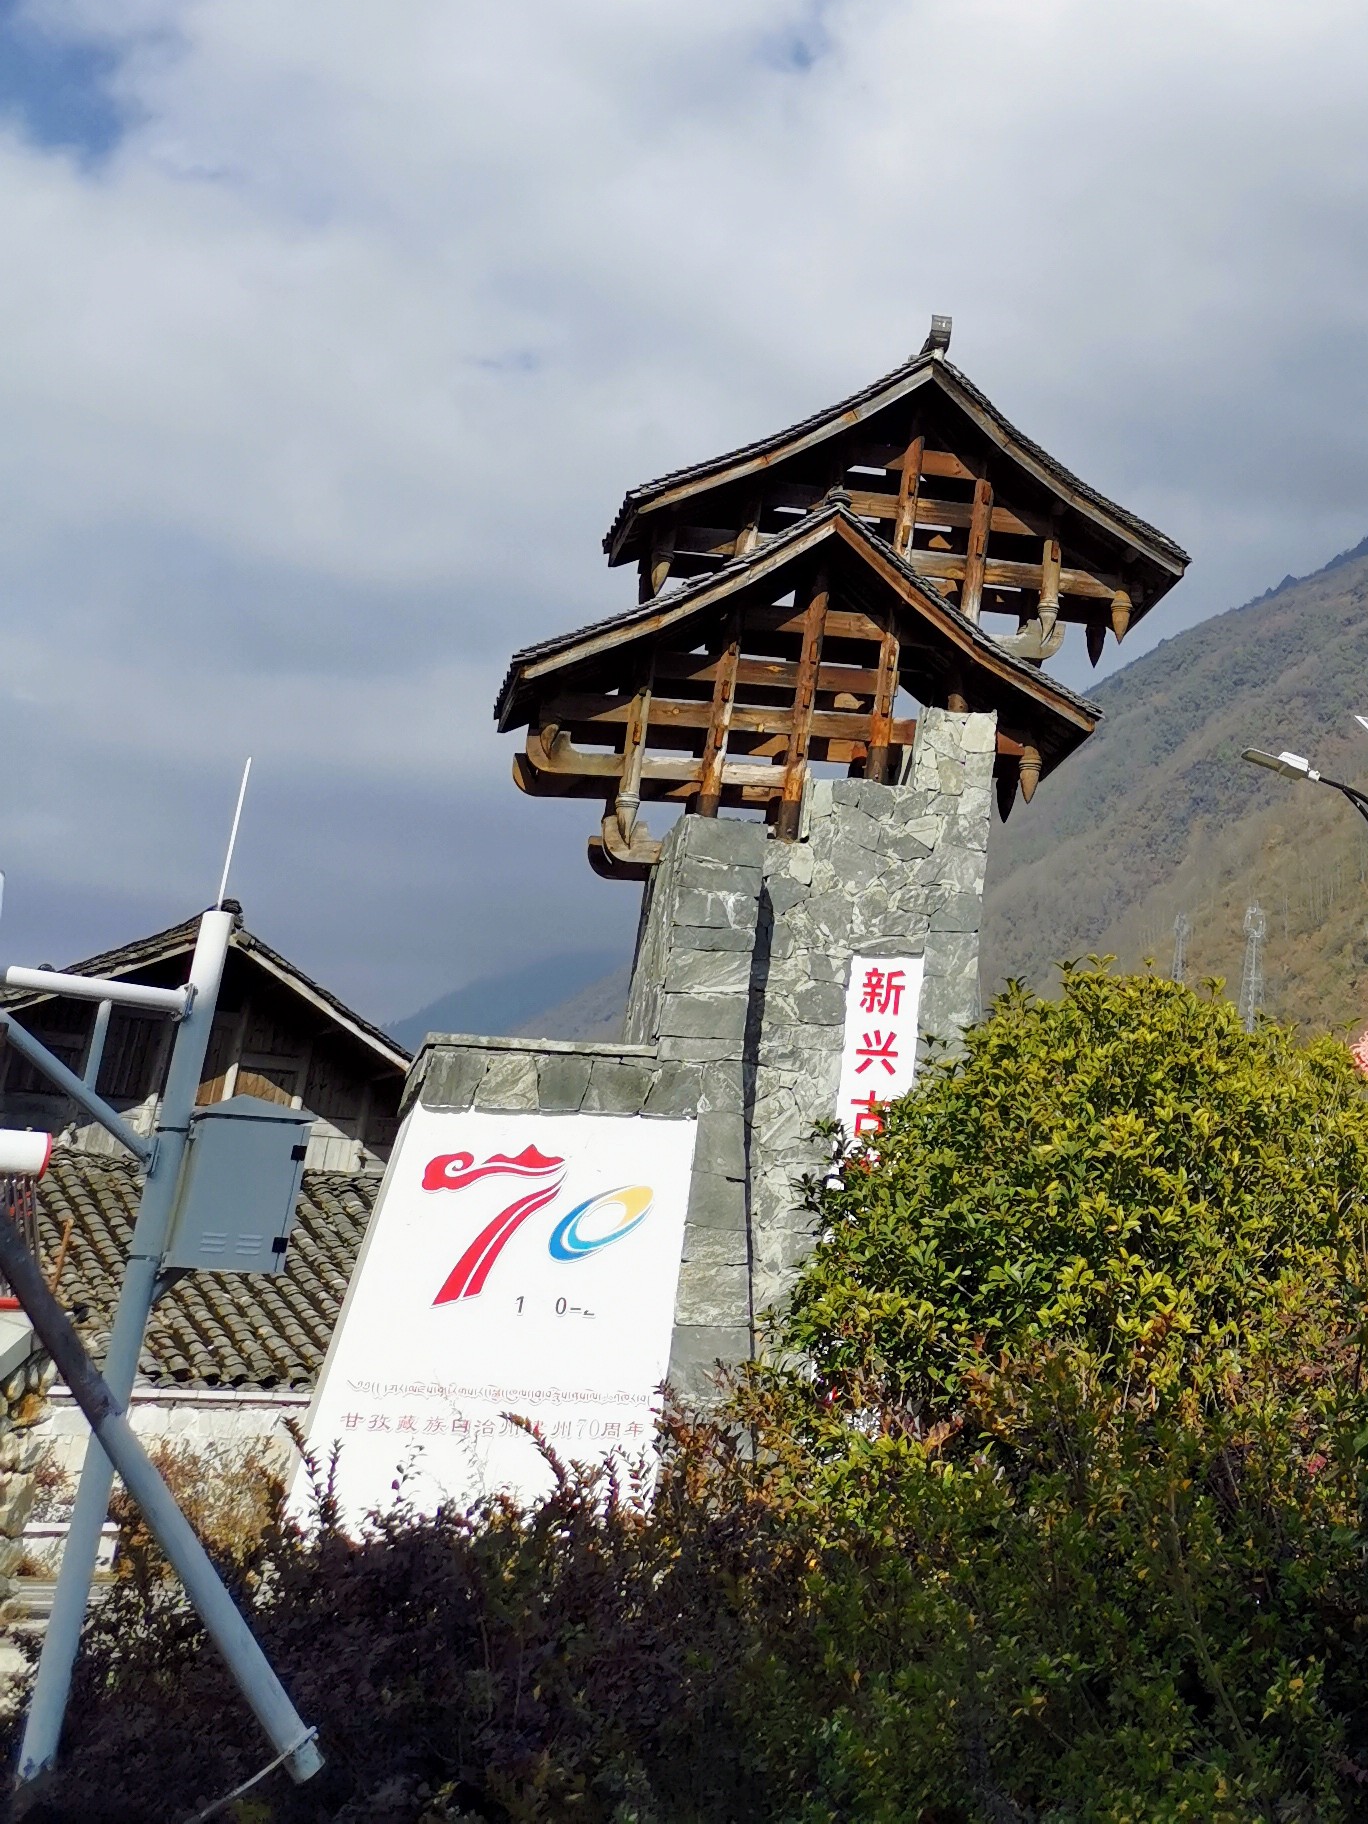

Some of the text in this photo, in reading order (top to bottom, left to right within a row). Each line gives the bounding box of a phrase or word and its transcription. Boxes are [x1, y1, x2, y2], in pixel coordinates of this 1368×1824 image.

[846, 967, 906, 1172] 新兴古
[421, 1143, 654, 1309] 70
